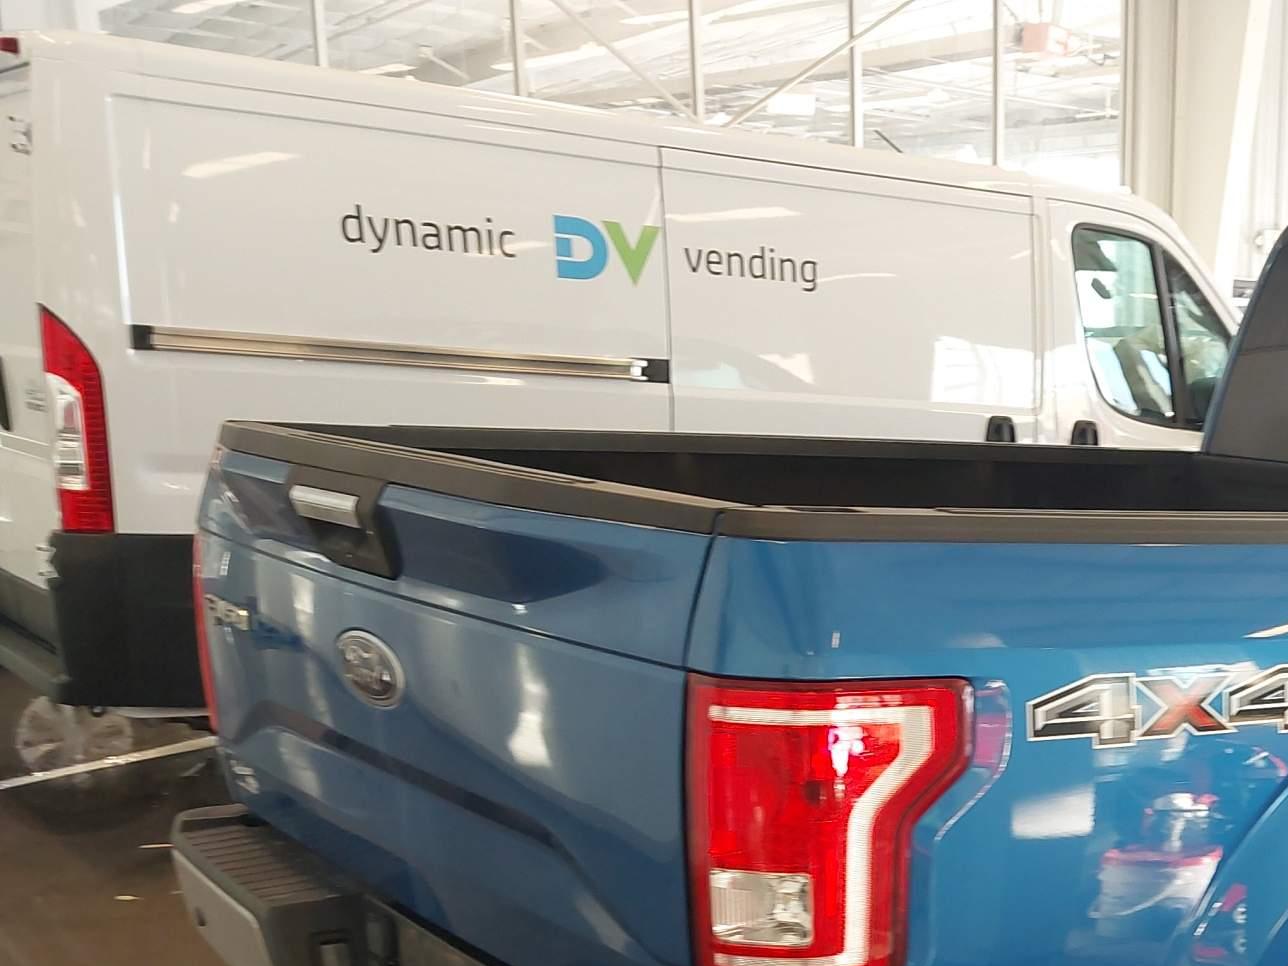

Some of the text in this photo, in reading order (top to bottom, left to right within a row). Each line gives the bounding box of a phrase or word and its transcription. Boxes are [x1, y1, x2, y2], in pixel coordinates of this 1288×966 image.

[341, 203, 818, 292] dynamic DV vending
